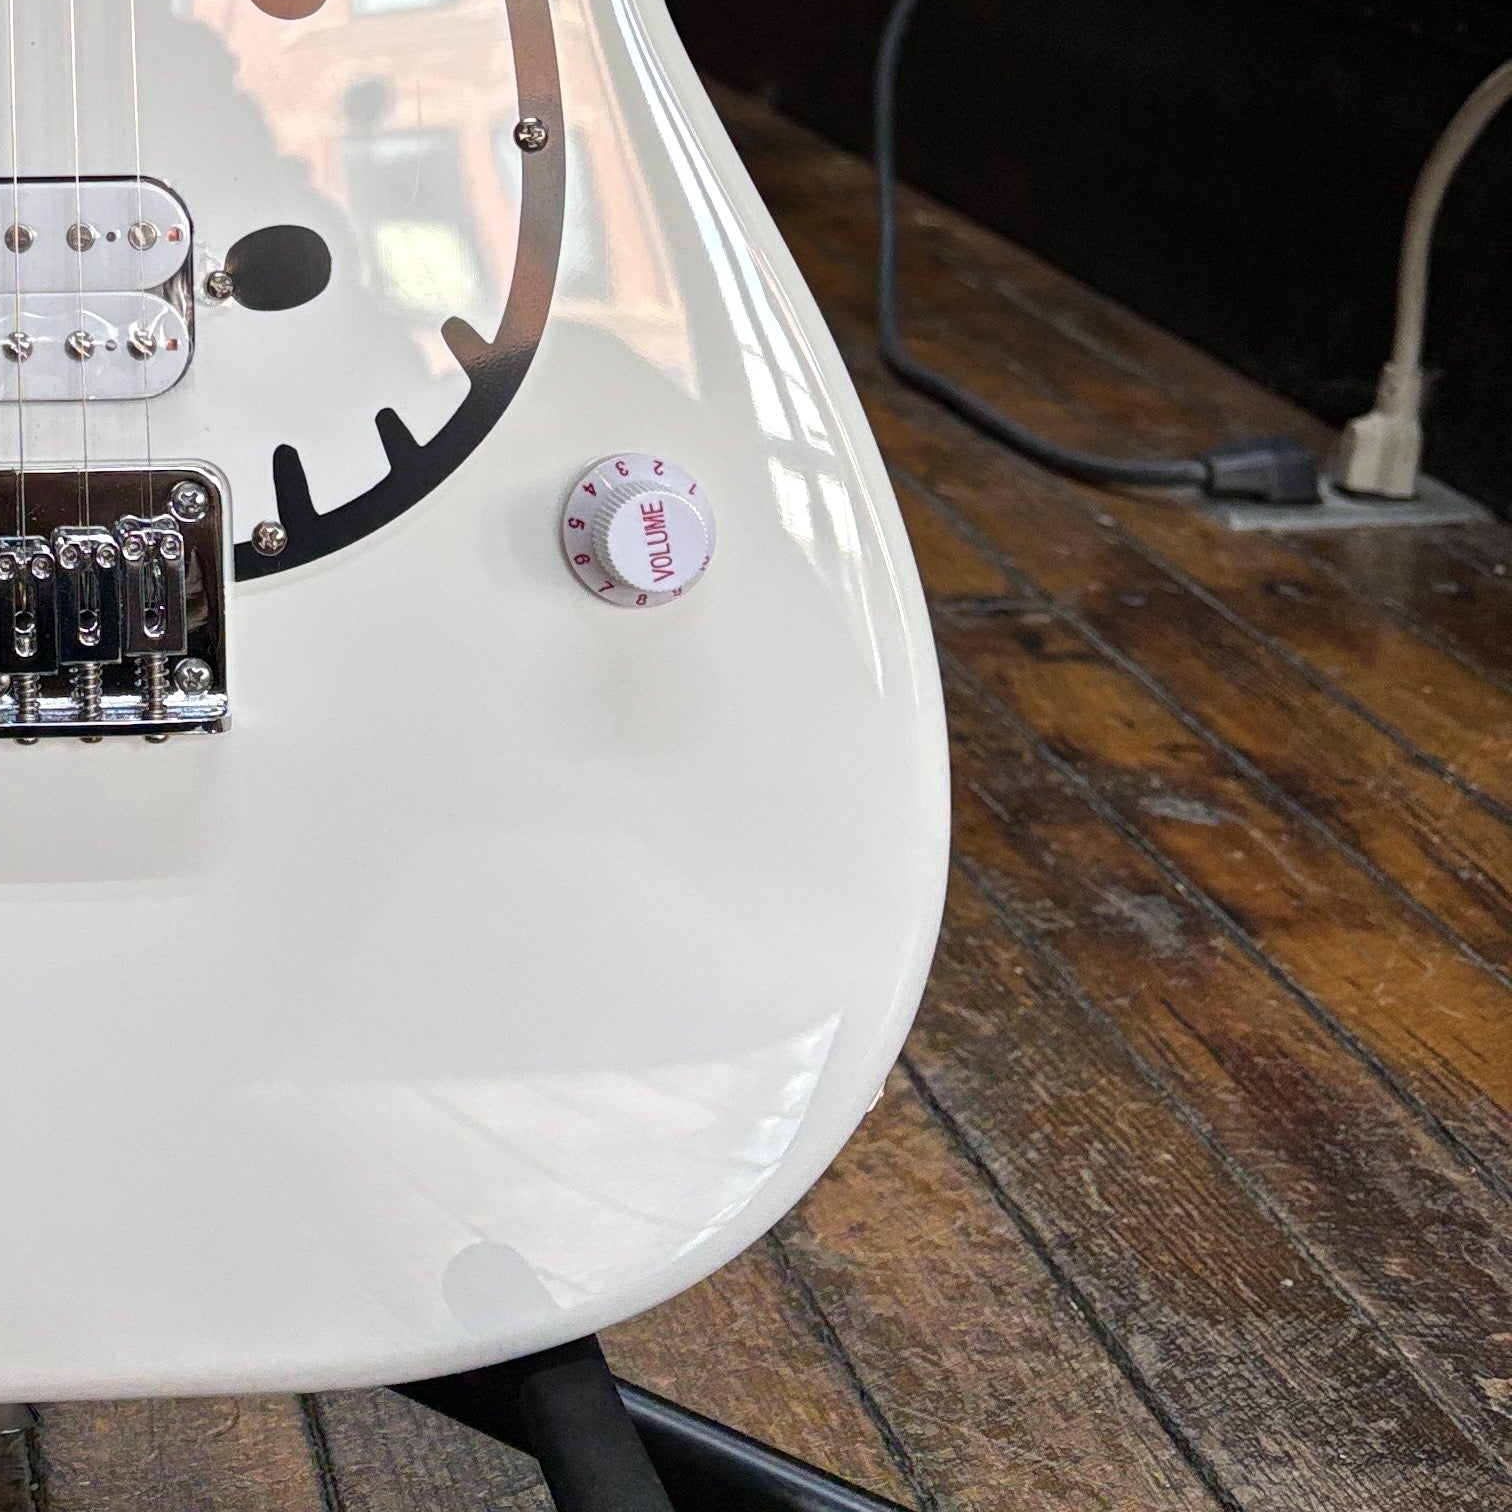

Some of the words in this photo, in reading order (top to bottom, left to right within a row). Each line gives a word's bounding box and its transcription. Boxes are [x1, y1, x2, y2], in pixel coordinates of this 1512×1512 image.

[615, 461, 629, 476] 3
[654, 460, 664, 476] 2
[582, 483, 597, 497] 4
[568, 518, 585, 530] 5
[640, 500, 675, 582] VOLUME
[599, 580, 614, 592] 7
